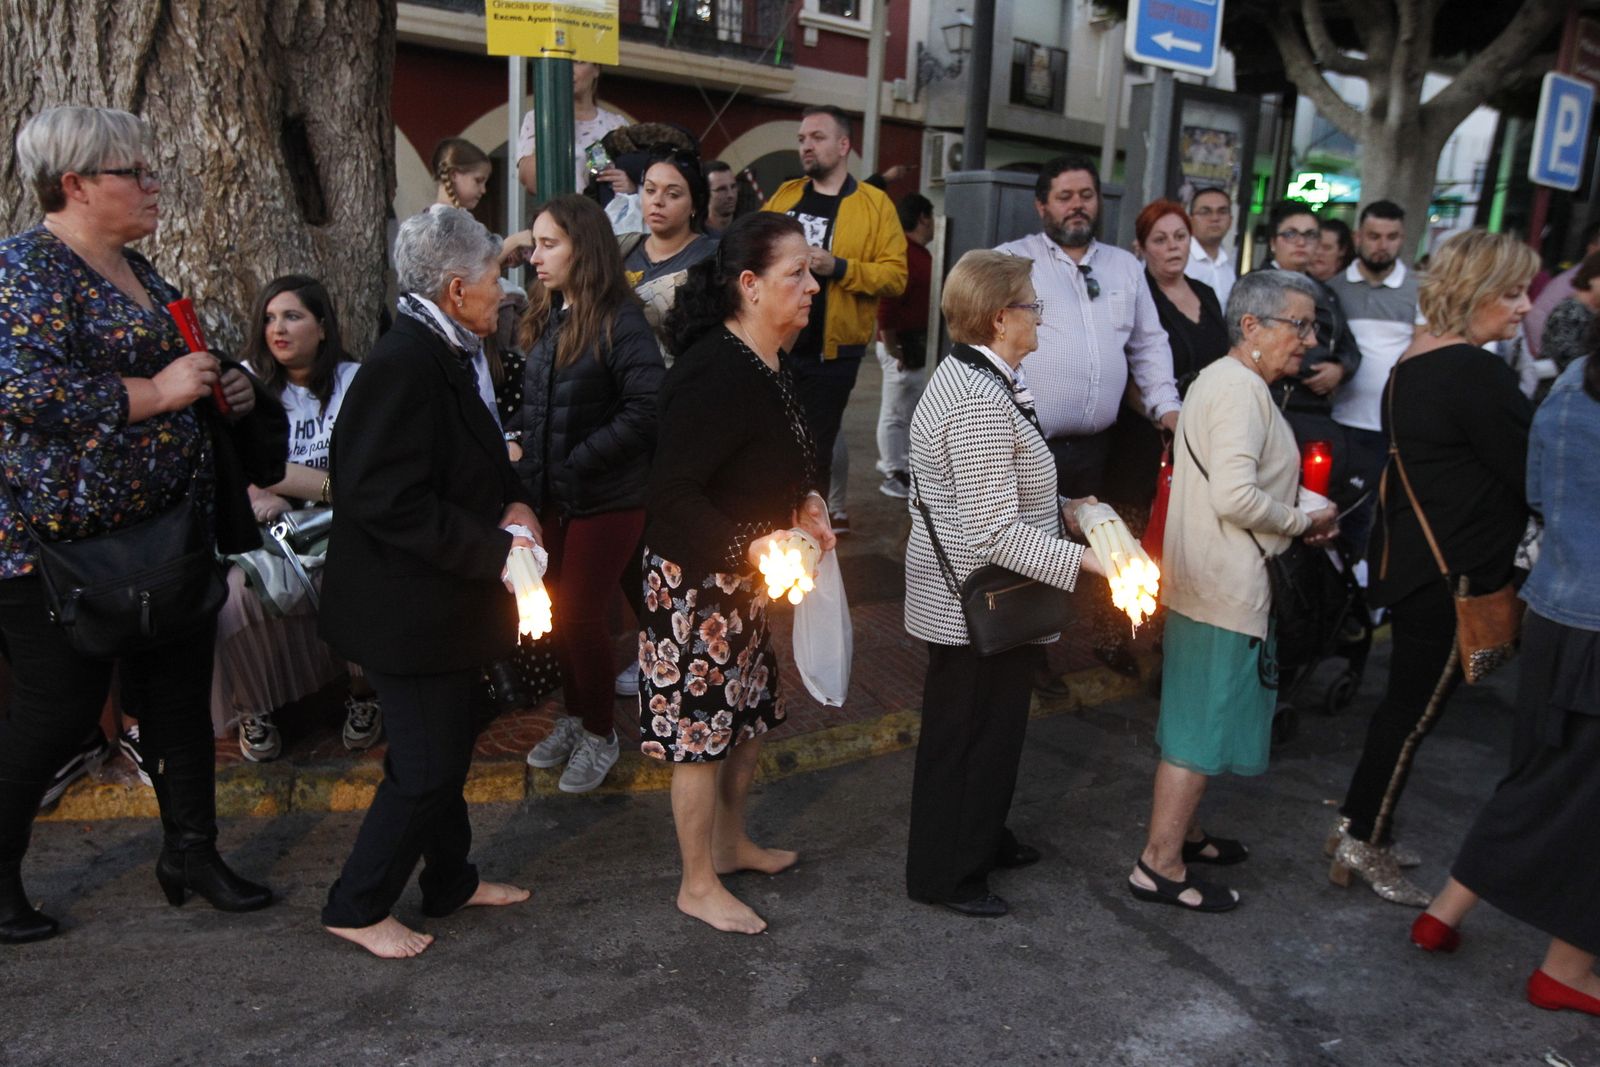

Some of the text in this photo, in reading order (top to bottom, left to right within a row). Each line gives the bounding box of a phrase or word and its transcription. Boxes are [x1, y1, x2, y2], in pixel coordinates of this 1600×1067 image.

[492, 0, 529, 10] Gracias
[533, 2, 548, 11] por
[494, 13, 525, 22] Excmo.
[528, 15, 580, 26] Ayuntamiento
[582, 20, 590, 28] de
[1548, 94, 1581, 172] P
[295, 415, 325, 439] HOY
